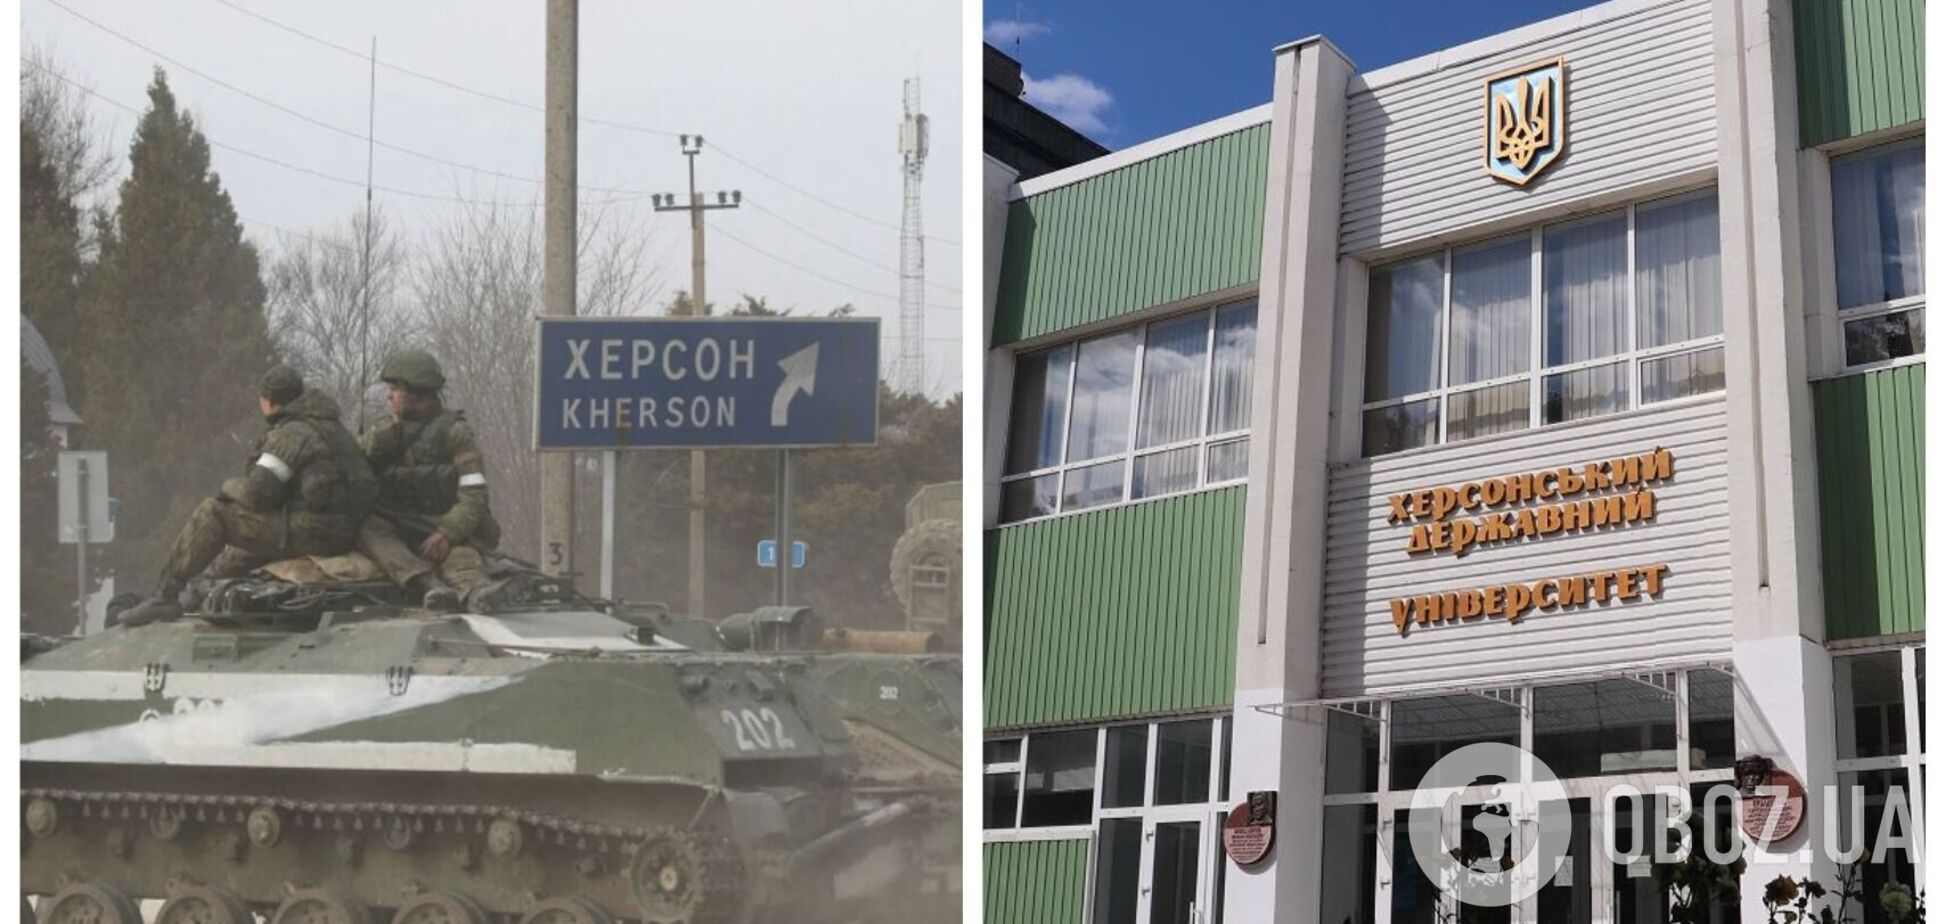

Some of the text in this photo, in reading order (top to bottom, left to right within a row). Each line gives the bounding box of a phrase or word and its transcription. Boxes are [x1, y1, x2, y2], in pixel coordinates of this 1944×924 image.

[564, 338, 755, 380] ХЕРСОН
[563, 396, 735, 428] KHERSON
[1387, 446, 1674, 523] ХЕРСОНСЬКИЙ
[1407, 487, 1656, 557] ДЕРЖАВНИЙ
[549, 542, 562, 566] 3
[1390, 564, 1670, 638] УНІВЕРСИТЕТ
[880, 686, 899, 699] 202
[721, 707, 795, 751] 202
